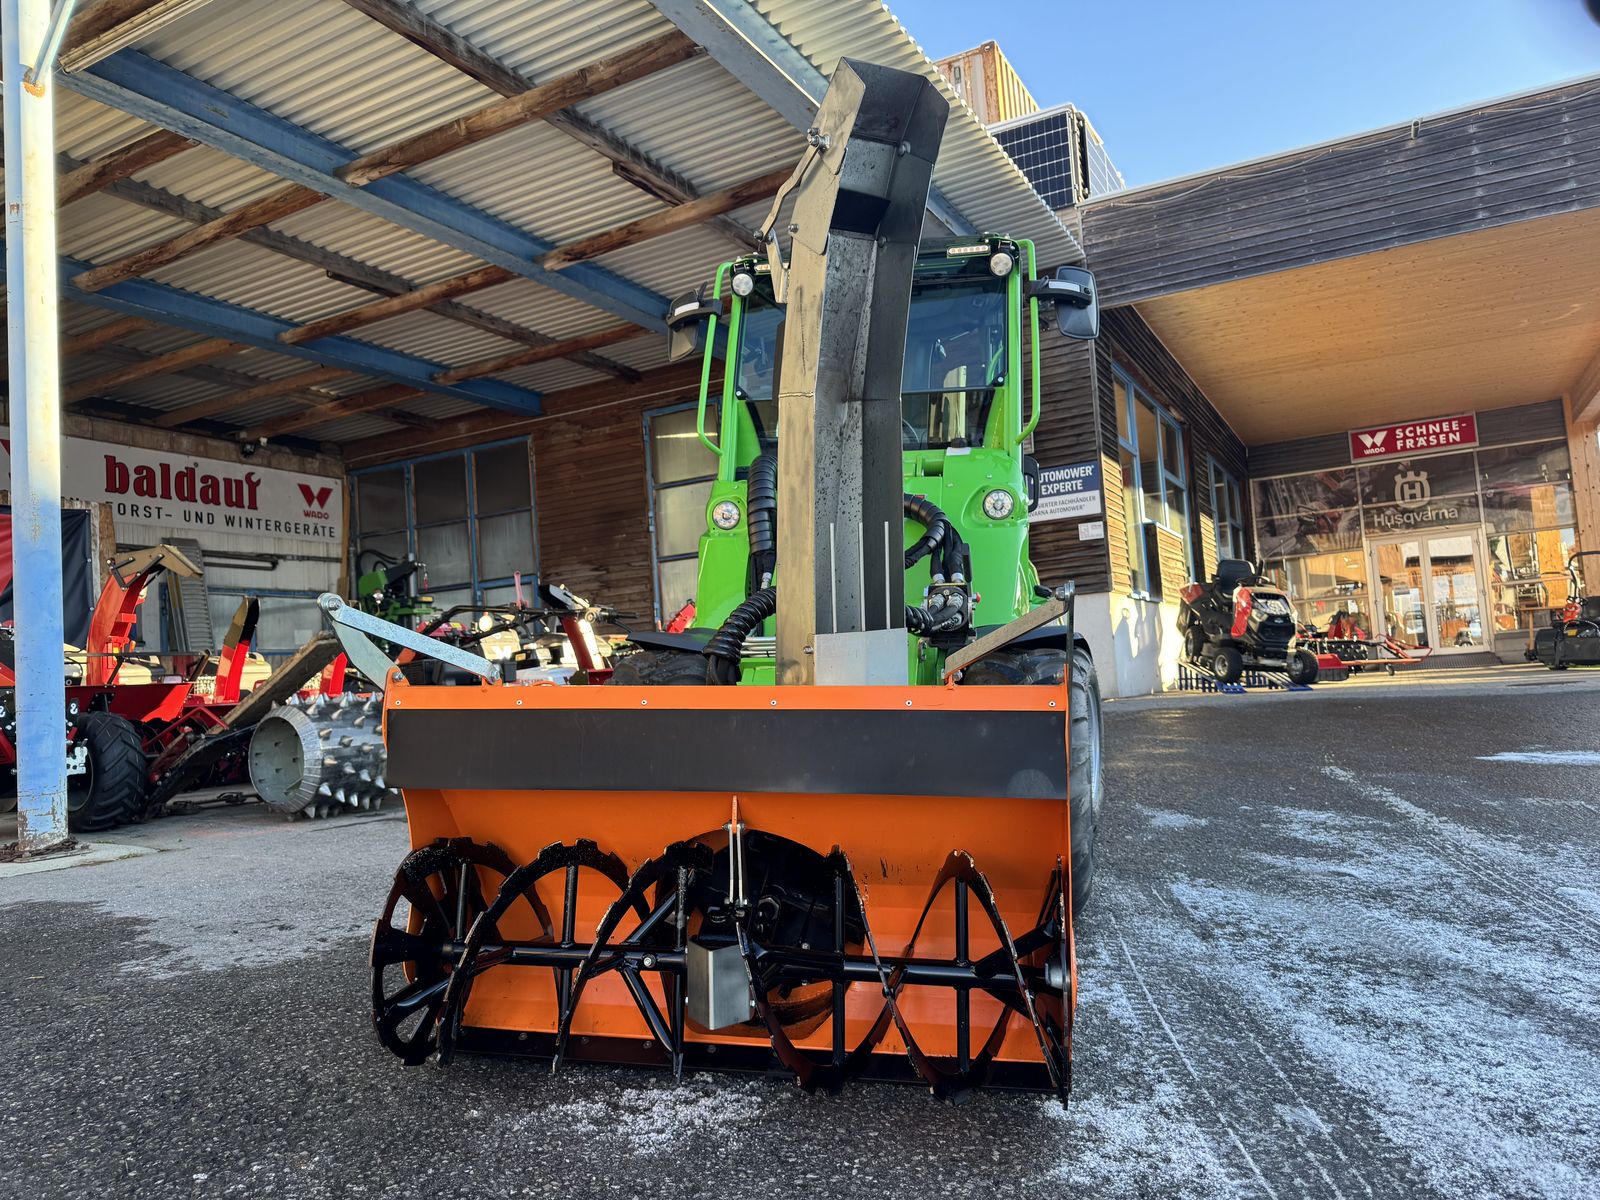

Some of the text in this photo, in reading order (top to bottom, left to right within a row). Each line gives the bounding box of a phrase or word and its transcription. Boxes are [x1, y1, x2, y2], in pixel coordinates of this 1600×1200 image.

[1395, 420, 1467, 439] SCHNEE-
[1396, 432, 1460, 450] FRÄSEN
[1363, 447, 1386, 455] WADO
[104, 455, 261, 510] baldauf
[1041, 480, 1083, 495] EXPERTE
[1058, 496, 1096, 506] FACHHÄNDLER
[105, 501, 335, 538] ORST- UND WINTERGERÄTE
[303, 509, 330, 521] WADO
[1374, 508, 1459, 526] Husqvarna
